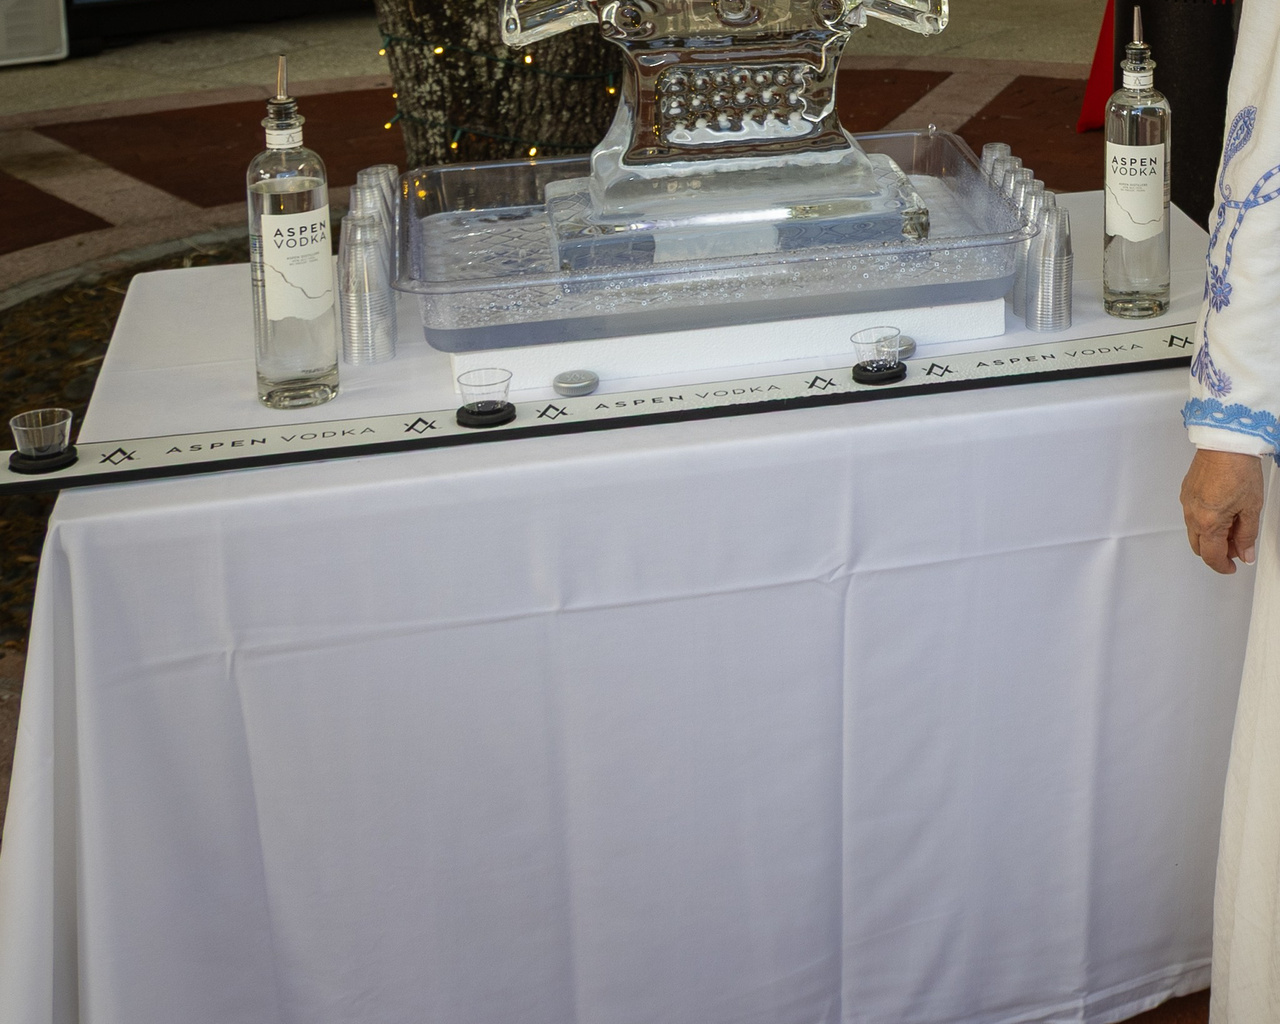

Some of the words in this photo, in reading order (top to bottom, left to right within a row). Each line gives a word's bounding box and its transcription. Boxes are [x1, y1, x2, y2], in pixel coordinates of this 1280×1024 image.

[1111, 156, 1157, 167] ASPEN
[1111, 165, 1157, 176] VODKA
[273, 220, 326, 238] ASPEN
[273, 232, 326, 249] VODKA
[976, 354, 1056, 368] ASPEN
[1065, 343, 1143, 357] VODKA
[595, 395, 683, 410] ASPEN
[695, 384, 781, 399] VODKA
[166, 438, 266, 454] ASPEN
[280, 427, 376, 442] VODKA
